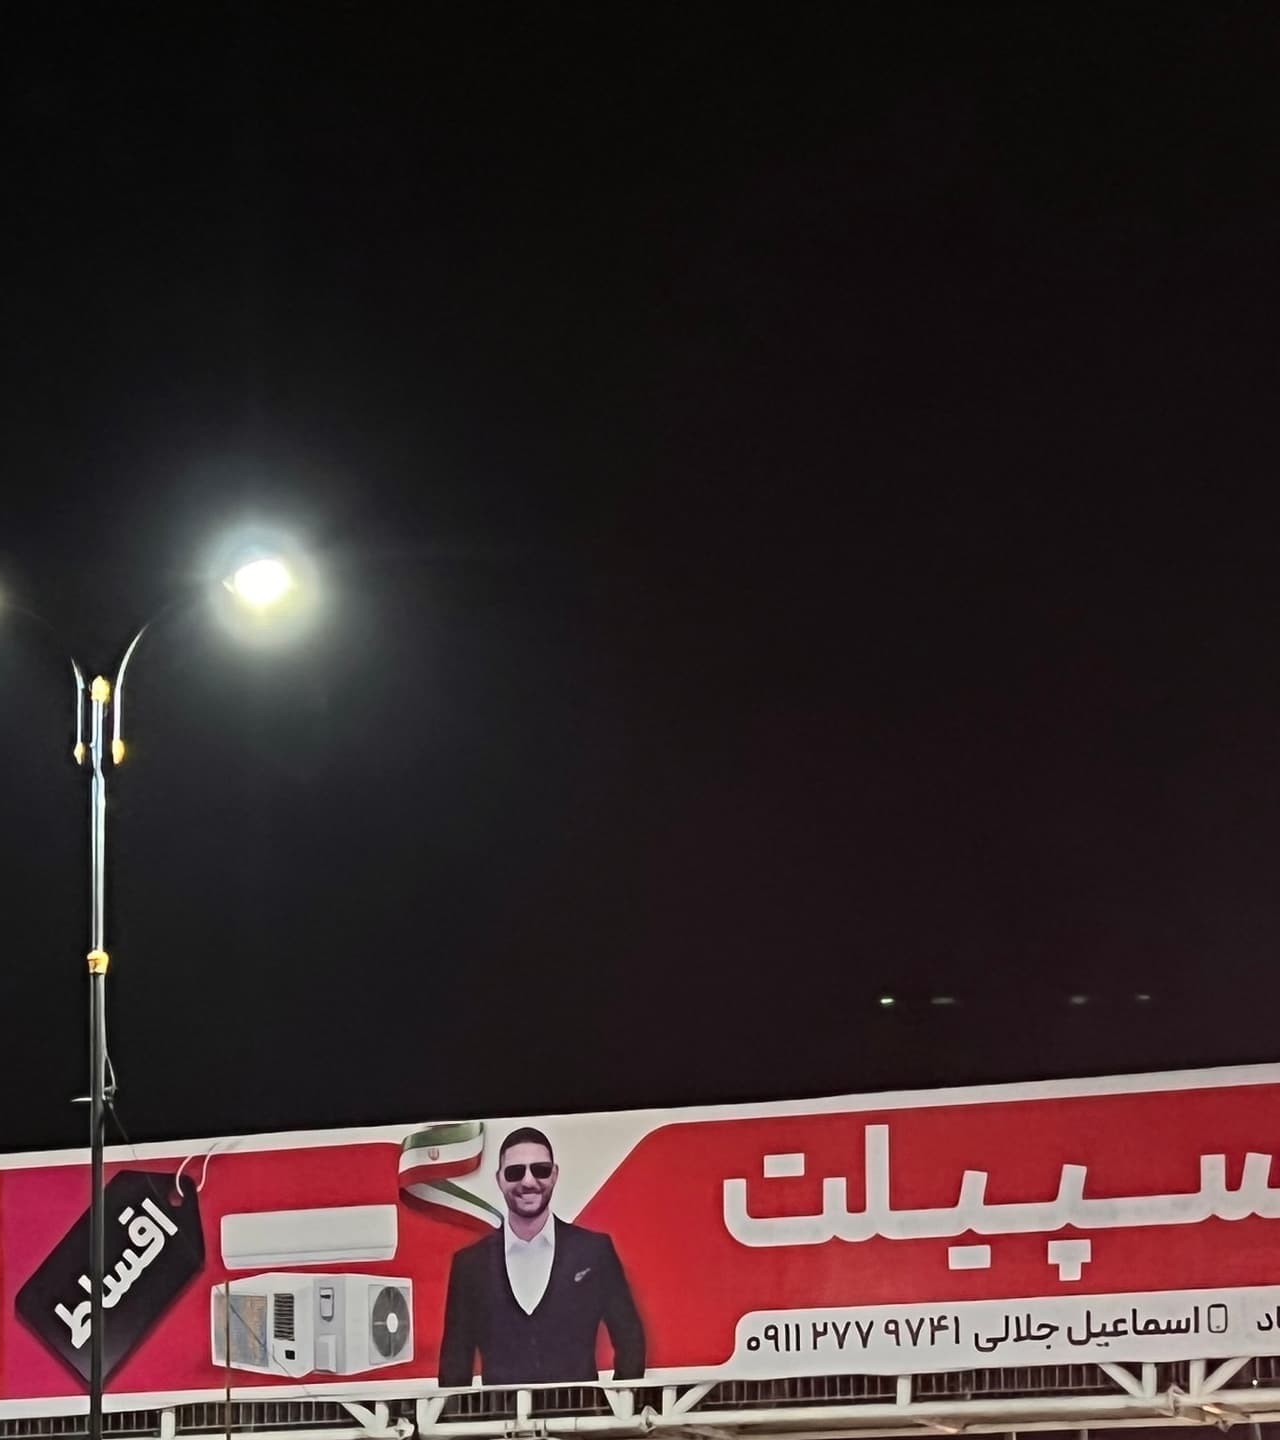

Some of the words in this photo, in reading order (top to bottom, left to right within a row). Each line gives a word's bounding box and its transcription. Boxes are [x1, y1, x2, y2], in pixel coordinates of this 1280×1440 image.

[54, 1197, 179, 1349] اقساط
[974, 1313, 1060, 1352] جلالی
[1067, 1305, 1200, 1346] اسماعیل
